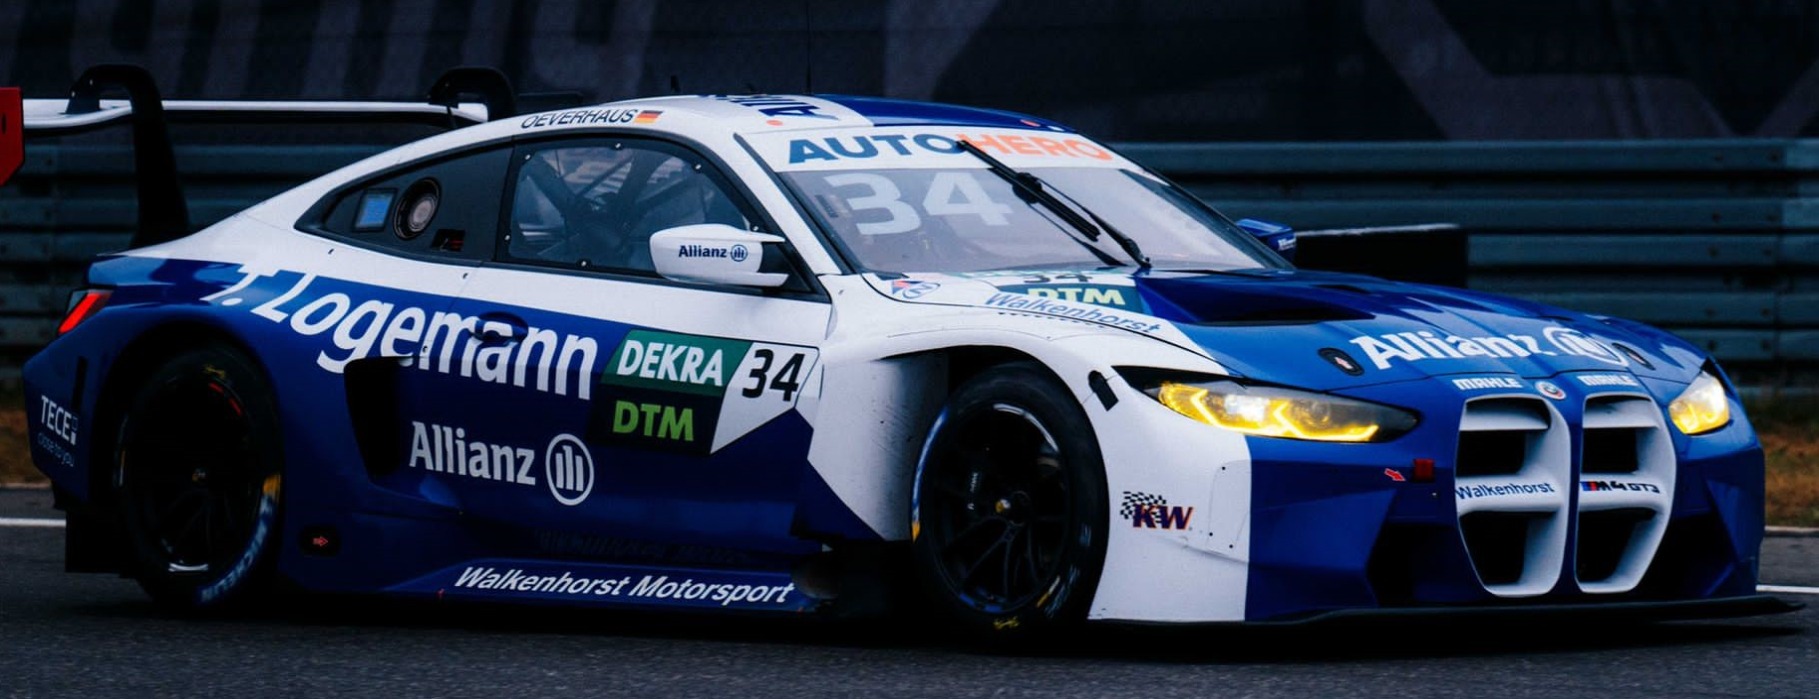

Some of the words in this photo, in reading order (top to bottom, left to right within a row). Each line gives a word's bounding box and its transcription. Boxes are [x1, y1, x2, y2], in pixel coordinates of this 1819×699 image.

[521, 109, 638, 129] OEVERHAUS
[822, 172, 1014, 236] 34
[678, 244, 728, 258] Allianz
[985, 291, 1160, 334] Walkenhorst
[1027, 287, 1126, 306] DTM
[250, 271, 598, 401] Logemann
[1349, 330, 1556, 370] Allianz
[616, 339, 724, 387] DEKRA
[741, 348, 806, 402] 34
[1576, 374, 1639, 388] MAHLE
[1452, 377, 1524, 391] MAHLE
[612, 400, 695, 442] DTM
[409, 420, 537, 487] Allianz
[1456, 481, 1555, 501] Walkenhorst
[1132, 503, 1195, 530] KW
[454, 566, 634, 598] Walkenhorst
[628, 574, 796, 606] Motorsport
